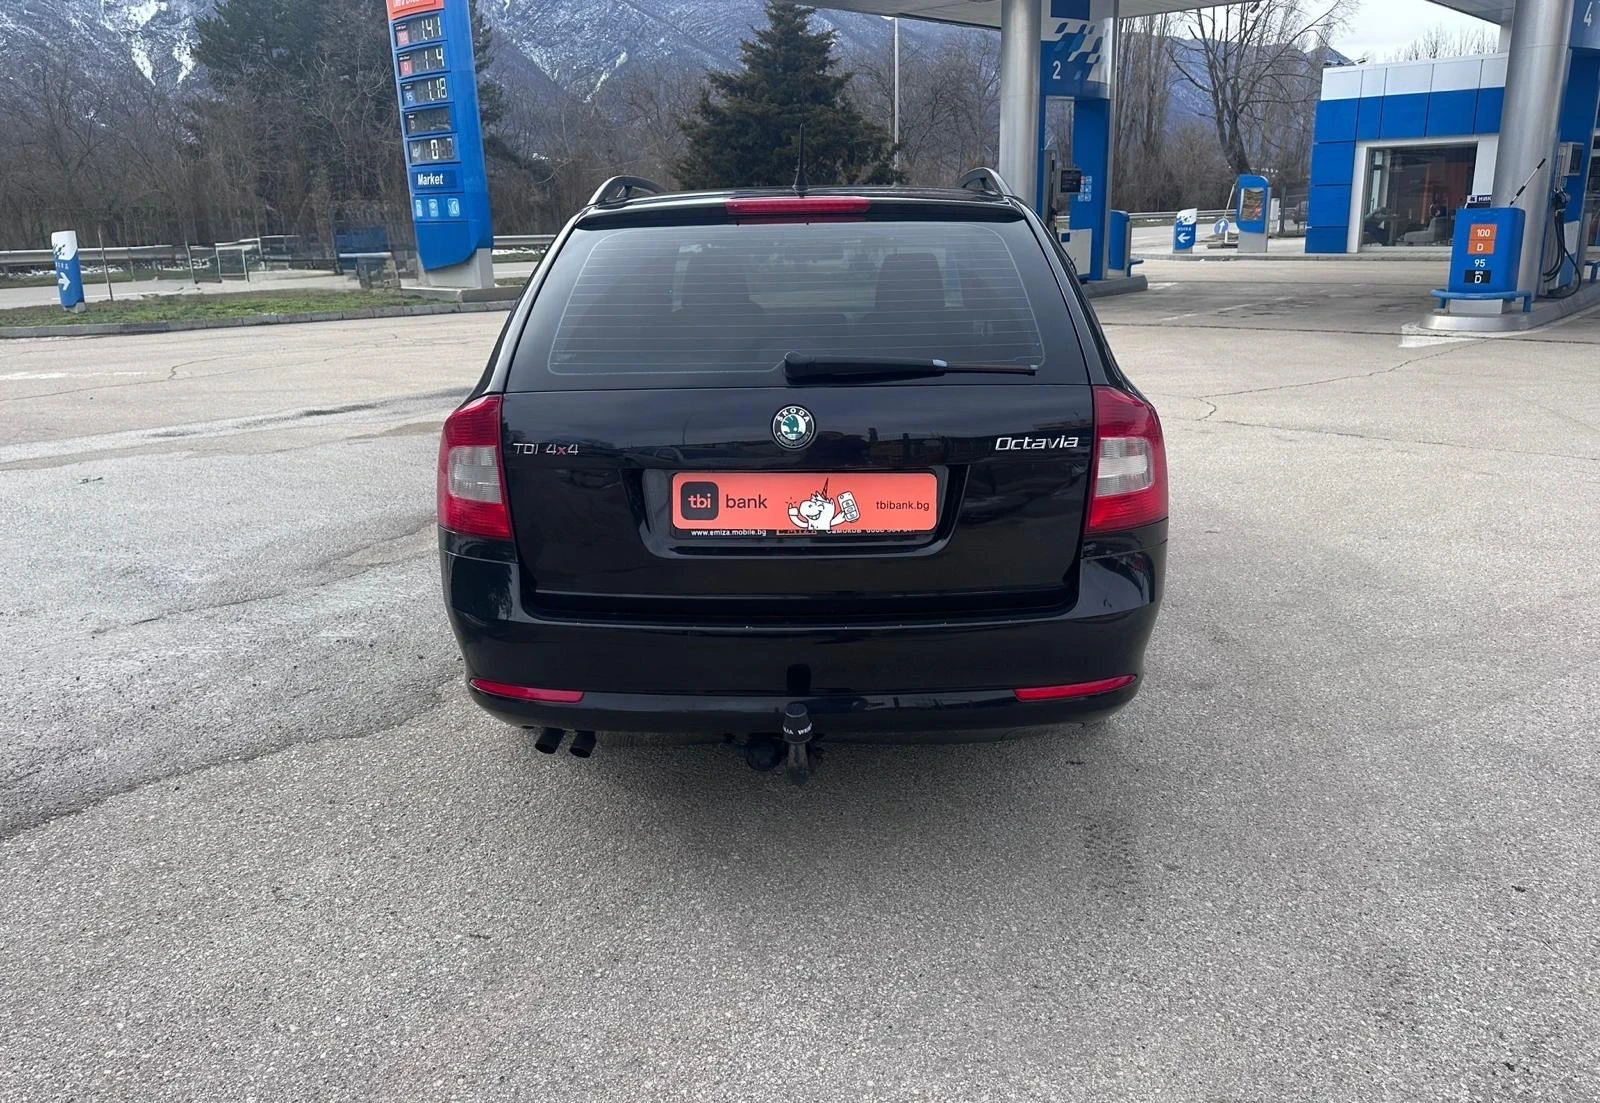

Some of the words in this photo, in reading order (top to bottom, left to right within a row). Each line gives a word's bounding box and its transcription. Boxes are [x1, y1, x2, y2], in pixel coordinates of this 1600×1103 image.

[1583, 2, 1592, 27] 4
[1052, 60, 1061, 79] 2
[417, 172, 444, 186] Market
[1476, 228, 1490, 237] 100
[1476, 243, 1484, 252] D
[1474, 258, 1486, 268] 95
[1474, 274, 1482, 284] D
[512, 442, 539, 455] TDI
[545, 444, 579, 456] 4x4
[994, 434, 1079, 451] Octavia
[687, 492, 712, 509] tbi
[725, 494, 768, 509] bank
[875, 500, 930, 512] tbibank.bg
[690, 529, 767, 537] www.emiza.mobile.bg
